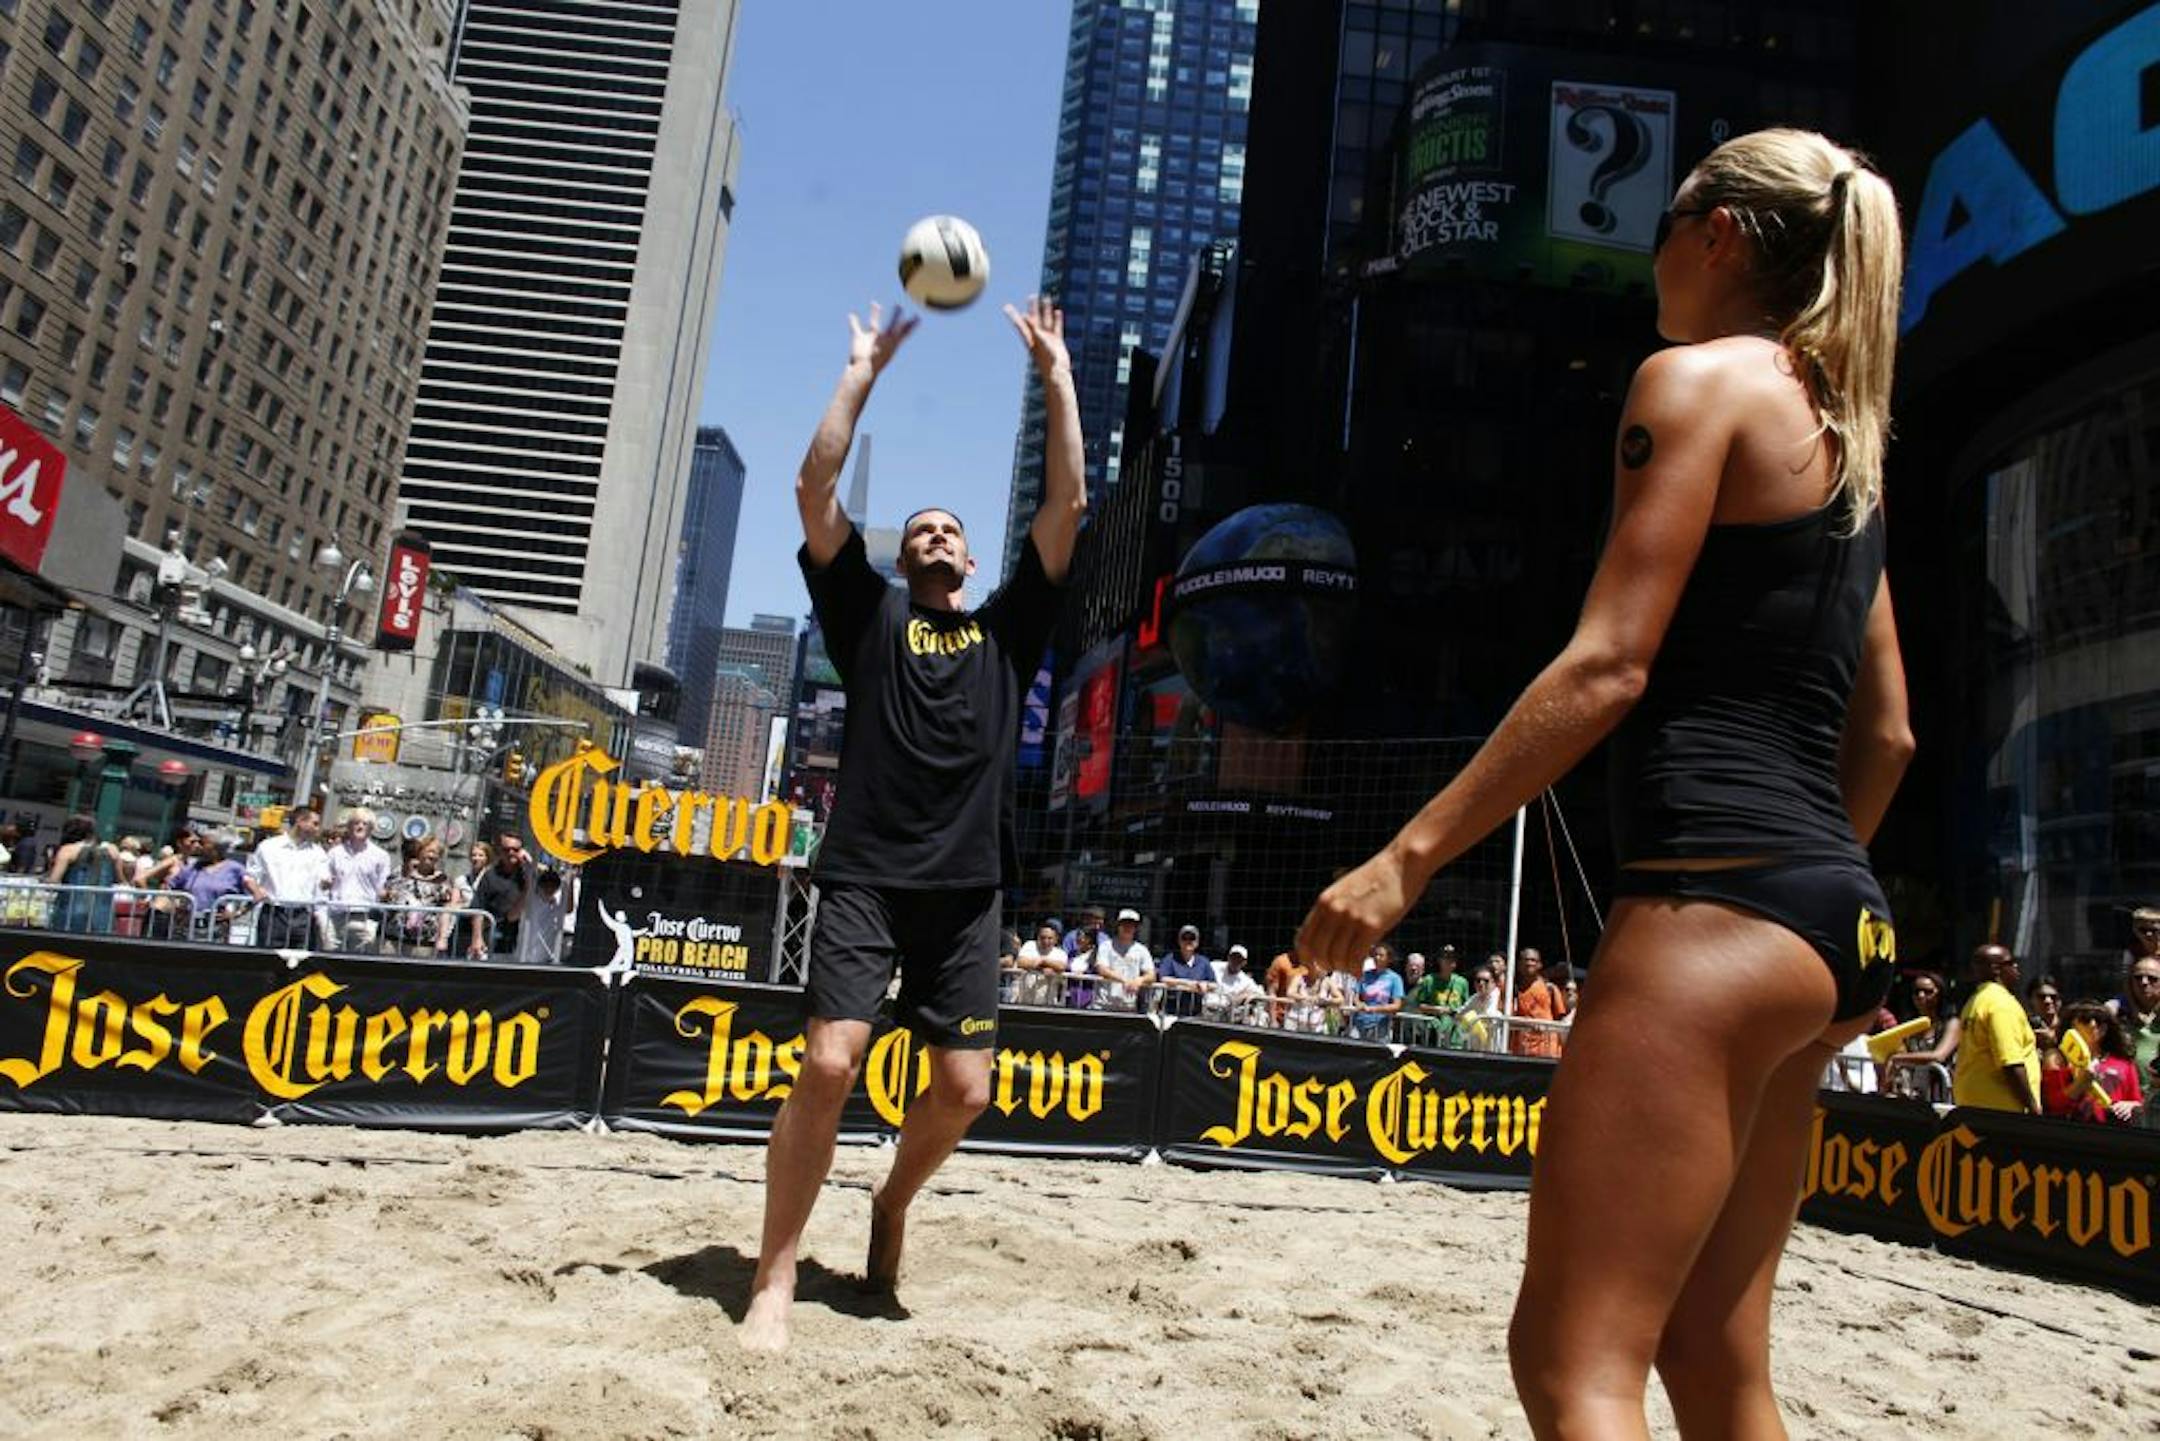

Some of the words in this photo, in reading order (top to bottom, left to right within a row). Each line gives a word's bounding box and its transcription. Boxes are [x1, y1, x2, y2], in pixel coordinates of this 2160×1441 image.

[1417, 181, 1517, 209] NEWEST
[1437, 220, 1501, 245] STAR
[1158, 435, 1183, 525] 1500
[529, 746, 796, 866] Cuervo
[635, 936, 678, 965] PRO
[682, 942, 749, 971] BEACH
[647, 911, 686, 939] Jose
[686, 916, 742, 942] Cuervo
[708, 969, 747, 980] SERIES
[0, 950, 229, 1089] Jose
[242, 971, 541, 1100] Cuervo
[660, 995, 808, 1118] Jos
[865, 1027, 1105, 1129] Crvo
[1201, 1040, 1358, 1150] Jose
[1916, 1123, 2152, 1258] Cuervo
